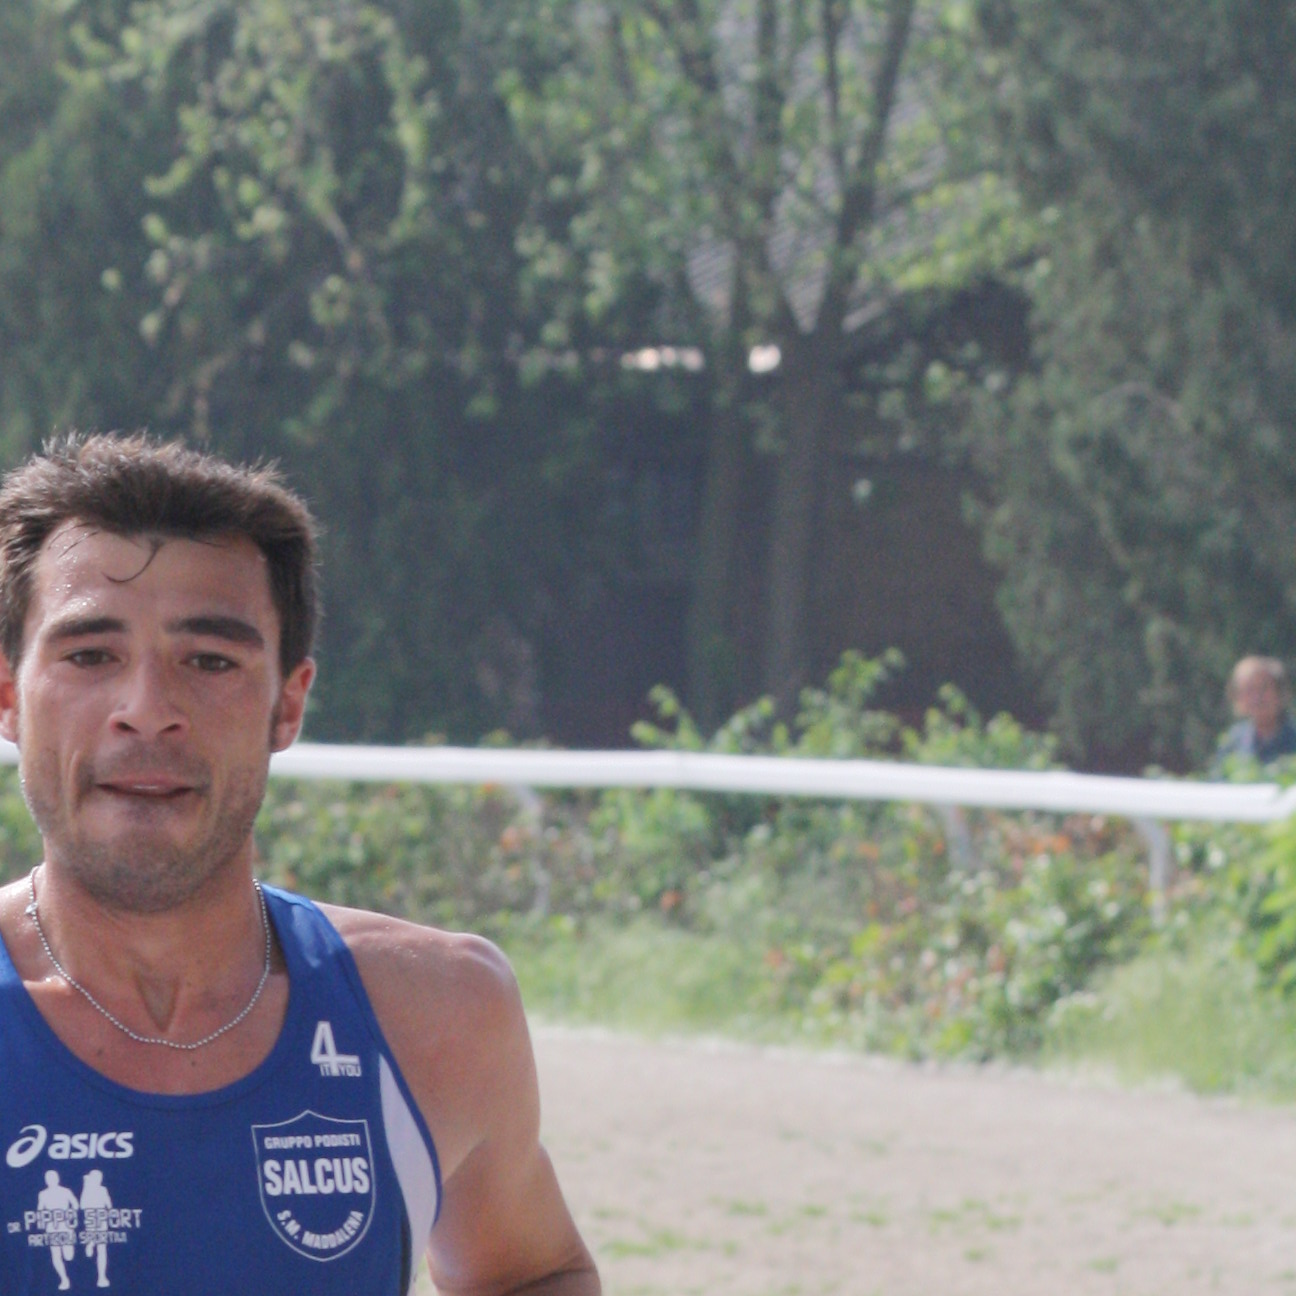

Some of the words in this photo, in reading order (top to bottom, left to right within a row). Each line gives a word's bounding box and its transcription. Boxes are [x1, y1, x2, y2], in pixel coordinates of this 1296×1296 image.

[263, 1135, 313, 1150] GRUPPO
[314, 1133, 361, 1148] PODISTI
[263, 1157, 370, 1196] SALCUS
[24, 1209, 78, 1231] PIPPO
[84, 1208, 142, 1232] SPORT
